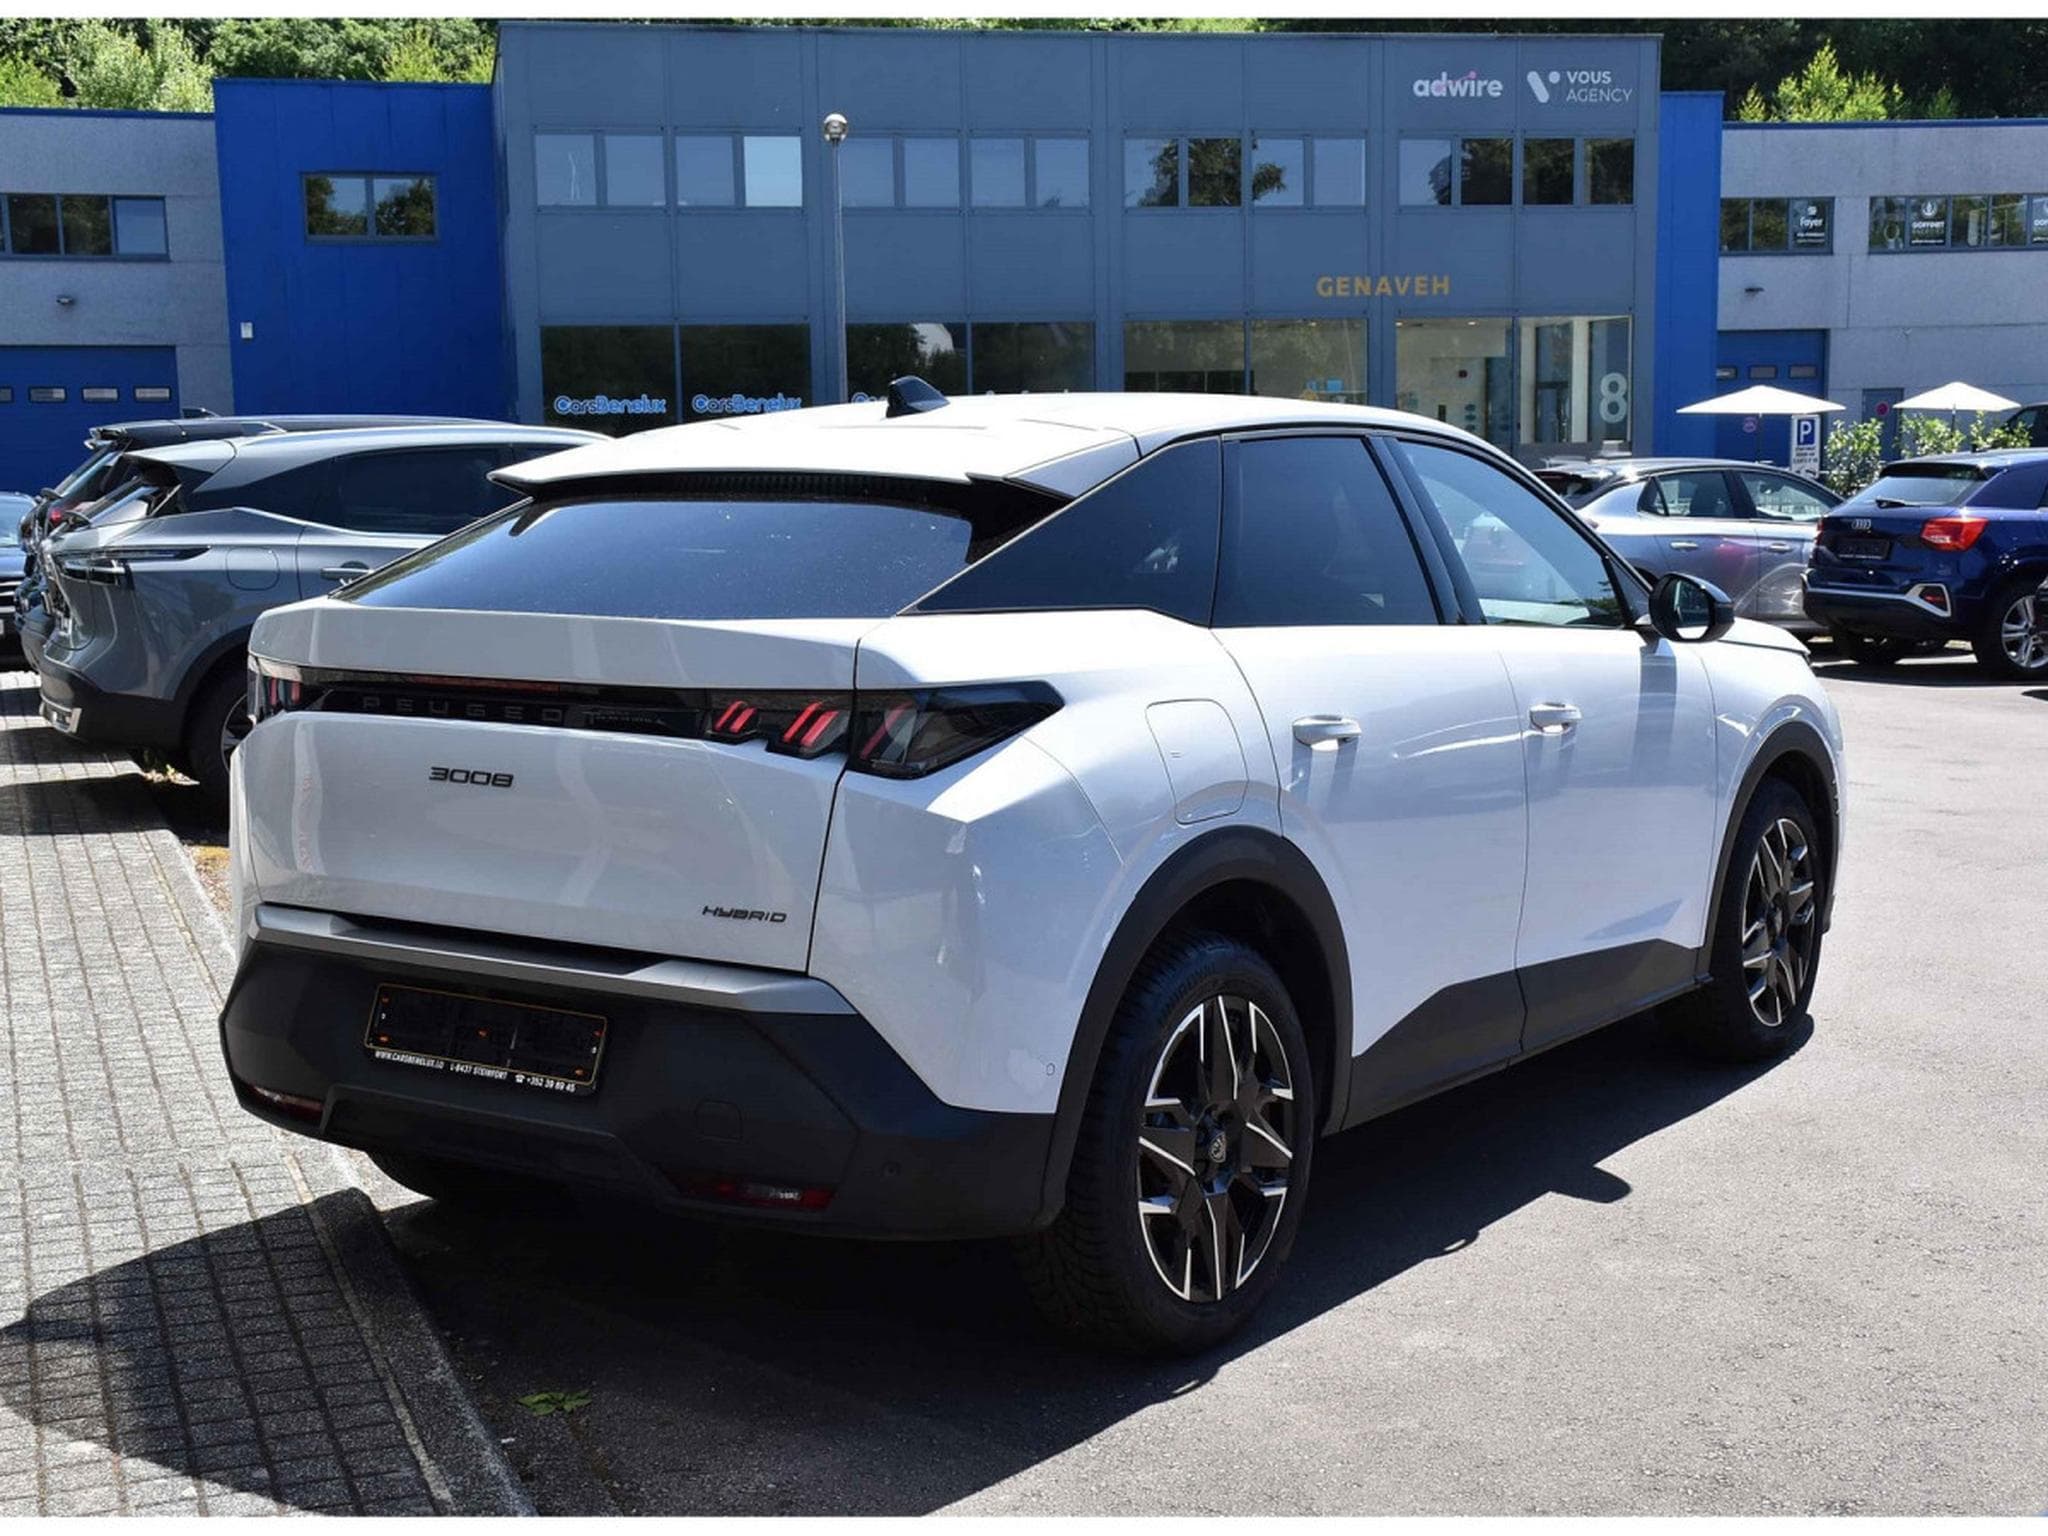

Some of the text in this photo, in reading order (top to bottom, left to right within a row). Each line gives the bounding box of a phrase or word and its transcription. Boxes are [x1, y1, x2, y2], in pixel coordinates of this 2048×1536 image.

[1412, 71, 1504, 98] adwire
[1566, 70, 1612, 85] VOUS
[1566, 88, 1633, 103] AGENCY
[1316, 275, 1450, 297] GENAVEH
[553, 394, 667, 415] CarsBenelux
[692, 393, 802, 414] CarsBenelux
[1600, 372, 1628, 424] 8
[428, 766, 514, 788] 3008
[702, 905, 787, 923] HYBRID
